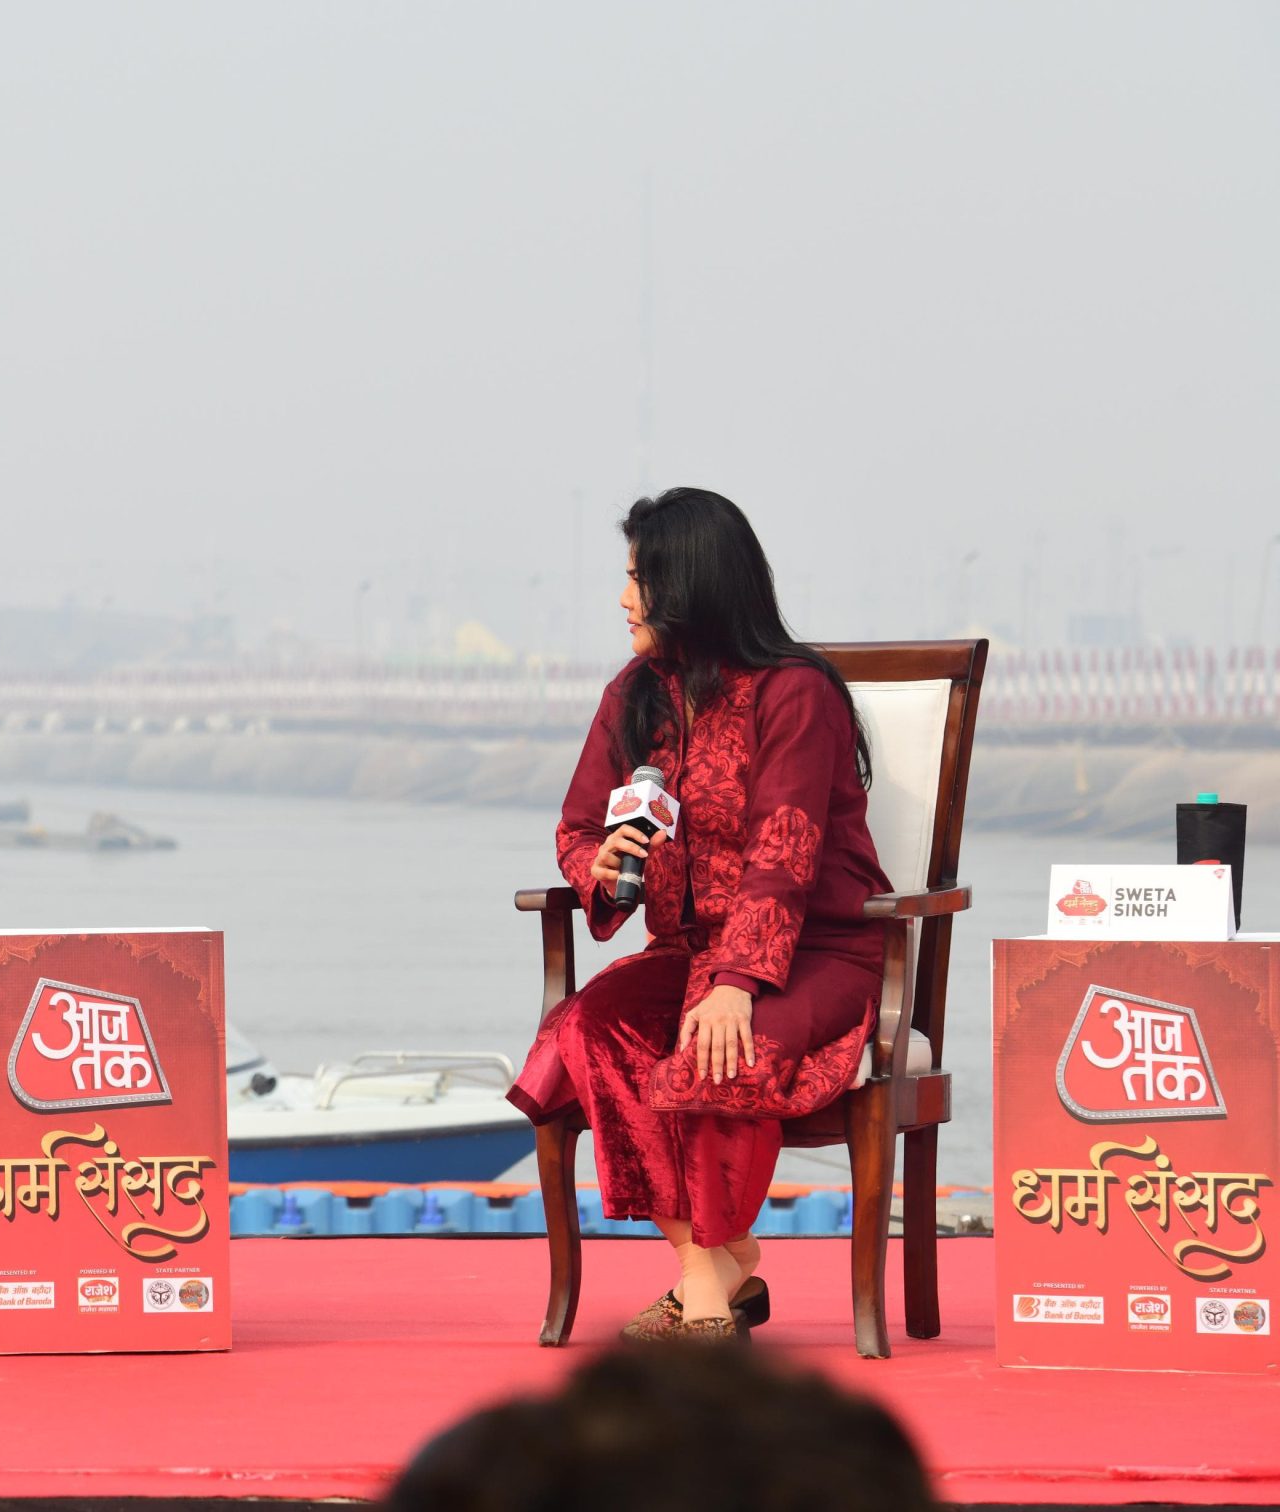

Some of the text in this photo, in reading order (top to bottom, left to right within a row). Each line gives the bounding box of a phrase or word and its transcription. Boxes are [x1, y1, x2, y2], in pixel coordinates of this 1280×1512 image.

[1113, 903, 1168, 917] SINGH
[1115, 888, 1177, 902] SWETA
[31, 991, 130, 1059] आज
[1081, 999, 1185, 1067] आज
[71, 1042, 153, 1091] तक
[1122, 1053, 1207, 1101] तक
[75, 1140, 217, 1258] संसद
[1011, 1135, 1274, 1277] धर्म संसद
[17, 1298, 25, 1306] of
[26, 1297, 52, 1305] Baroda
[84, 1283, 113, 1297] राजेश
[1044, 1311, 1101, 1320] Bank of Baroda
[1135, 1300, 1164, 1313] राजेश
